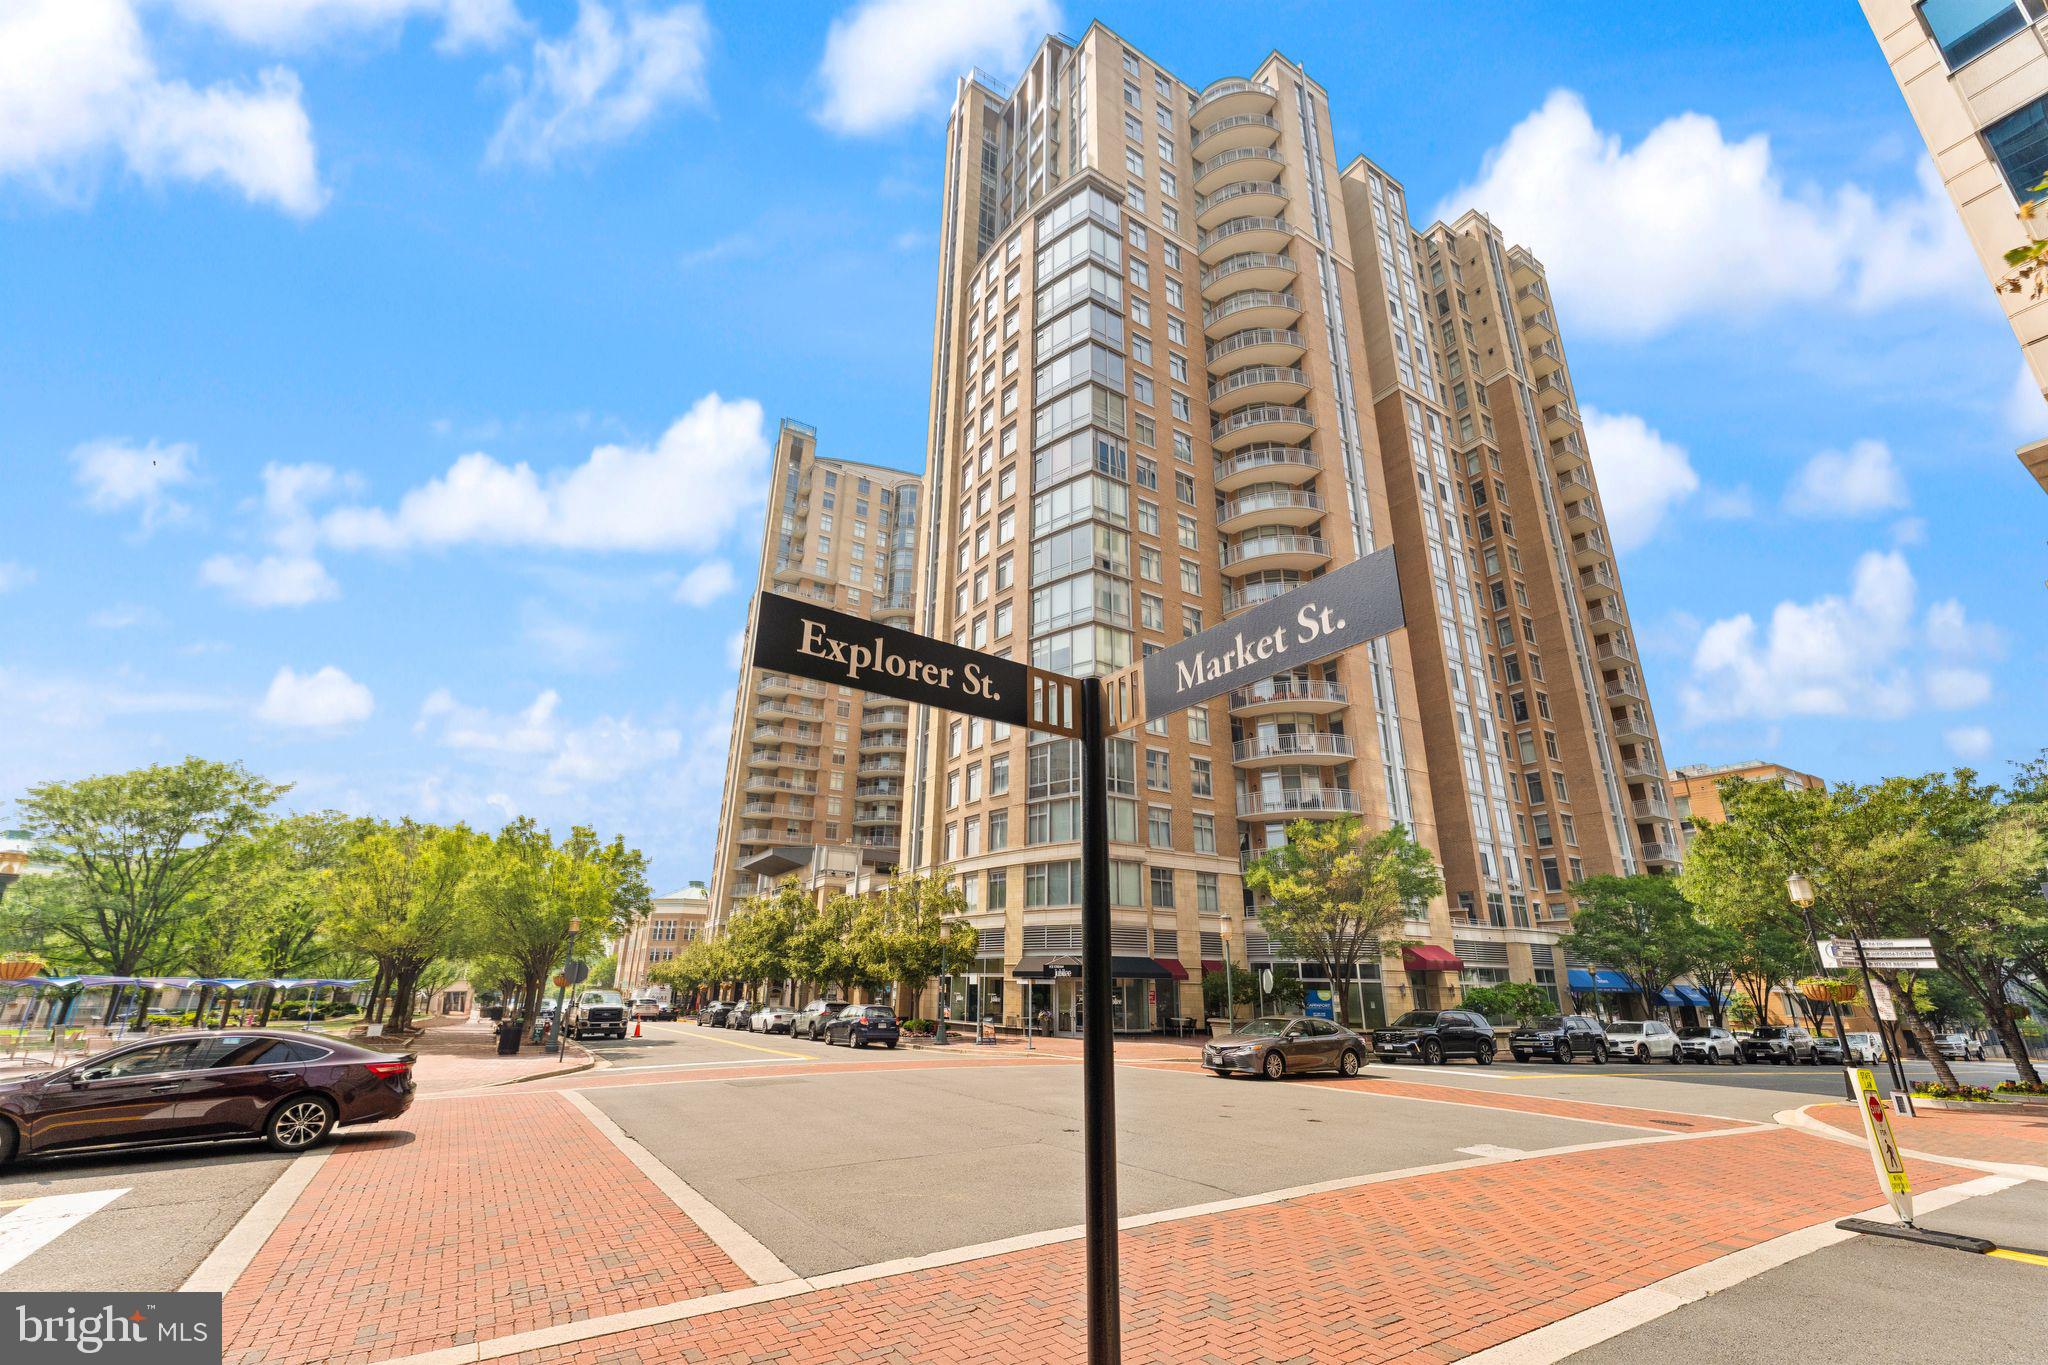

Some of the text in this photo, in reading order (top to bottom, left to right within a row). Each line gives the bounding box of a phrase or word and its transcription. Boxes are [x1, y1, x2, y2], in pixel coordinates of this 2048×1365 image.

[796, 618, 1001, 701] Explorer St.
[1175, 602, 1346, 693] Market St.
